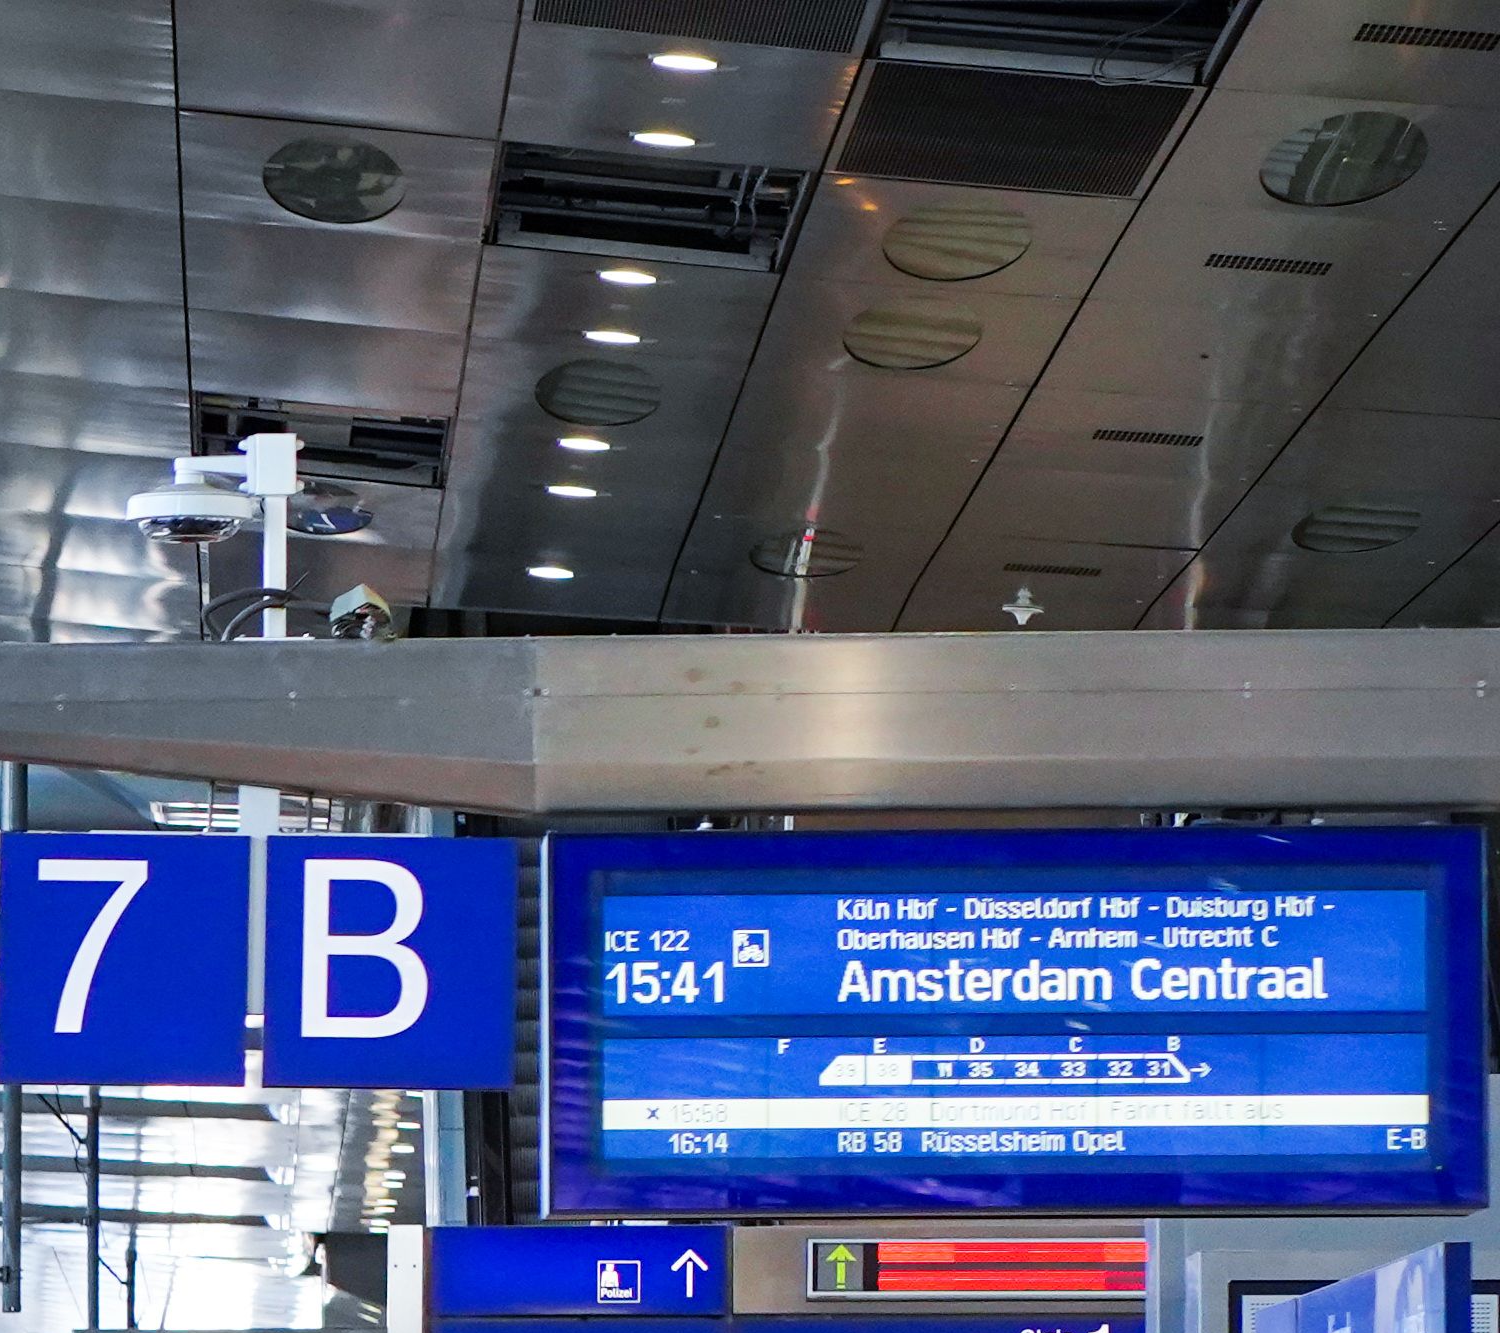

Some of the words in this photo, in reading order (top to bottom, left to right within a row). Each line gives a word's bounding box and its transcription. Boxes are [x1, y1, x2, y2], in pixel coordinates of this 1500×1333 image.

[837, 897, 890, 920] Köln
[897, 898, 939, 920] Hbf
[964, 896, 1092, 920] Düsseldorf
[1099, 896, 1141, 919] Hbf
[1166, 896, 1269, 922] Duisburg
[1275, 895, 1316, 917] Hbf
[38, 858, 149, 1034] 7
[301, 858, 428, 1038] B
[605, 930, 639, 952] ICE
[649, 930, 690, 952] 122
[837, 927, 975, 951] Oberhausen
[981, 927, 1023, 949] Hbf
[1048, 927, 1138, 949] Arnhem
[1163, 926, 1254, 948] Utrecht
[1261, 925, 1279, 947] C
[605, 961, 724, 1004] 15:41
[837, 959, 1113, 1003] Amsterdam
[1131, 957, 1329, 1000] Centraal
[777, 1038, 791, 1055] F
[873, 1037, 887, 1054] E
[969, 1037, 986, 1054] D
[1069, 1036, 1083, 1053] C
[1167, 1035, 1181, 1052] B
[967, 1061, 994, 1078] 35
[1014, 1061, 1040, 1078] 34
[1060, 1060, 1087, 1078] 33
[1107, 1060, 1133, 1077] 32
[1147, 1060, 1171, 1077] 31
[671, 1103, 729, 1123] 15:58
[839, 1102, 870, 1122] ICE
[930, 1101, 1040, 1122] Dortmund
[1111, 1100, 1173, 1120] Fahrt
[1245, 1102, 1284, 1120] aus
[668, 1132, 729, 1154] 16:14
[837, 1131, 867, 1153] RB
[873, 1131, 903, 1153] 58
[921, 1129, 1066, 1153] Rüsselsheim
[1072, 1130, 1126, 1155] Opel
[1387, 1128, 1426, 1150] E-B
[600, 1287, 634, 1299] Polizei
